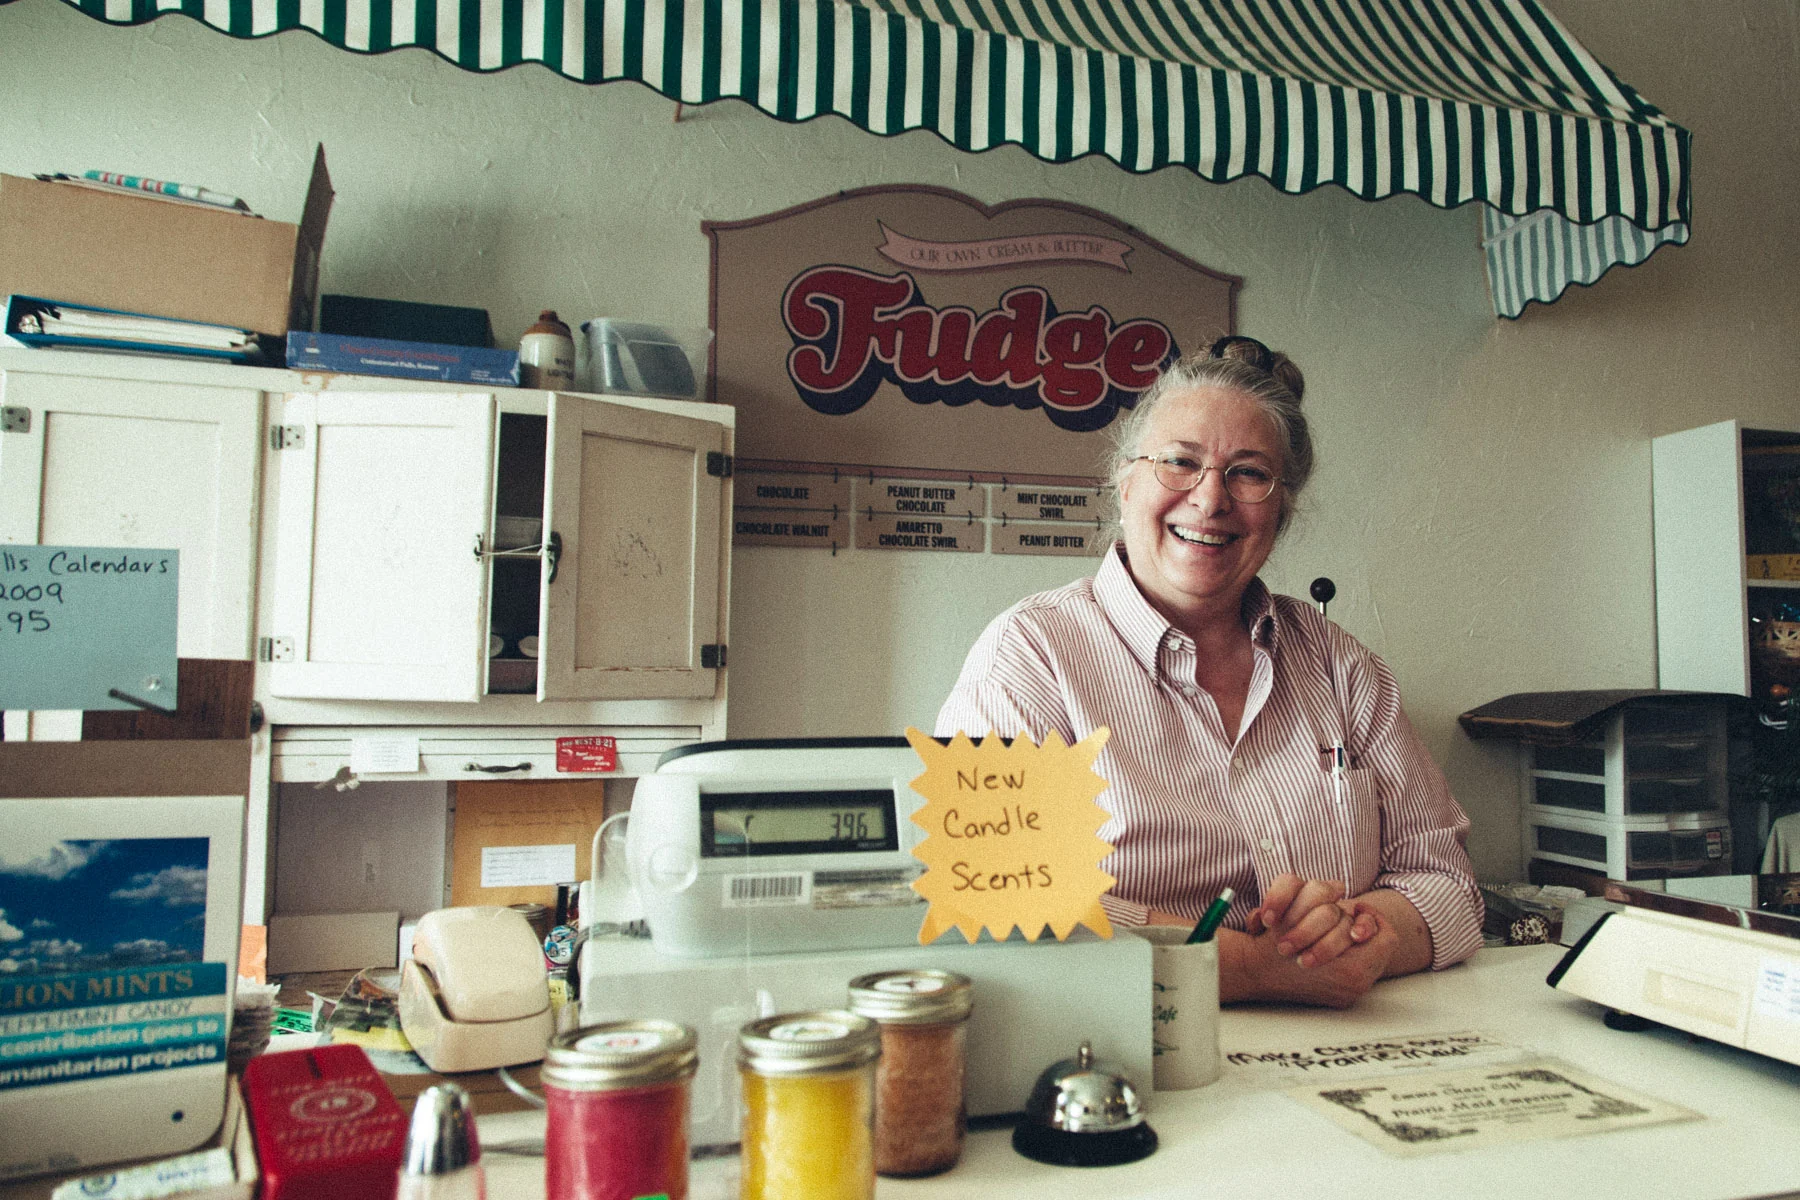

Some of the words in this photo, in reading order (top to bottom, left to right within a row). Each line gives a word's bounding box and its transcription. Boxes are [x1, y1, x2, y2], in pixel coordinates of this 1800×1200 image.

[910, 248, 940, 262] OUR
[946, 249, 981, 262] OWN
[988, 242, 1033, 258] CREAM
[780, 265, 1174, 412] Fudge
[757, 486, 809, 500] CHOCOLATE
[887, 485, 921, 498] PEANUT
[923, 487, 956, 500] BUTTER
[1017, 492, 1038, 505] MINT
[1040, 494, 1087, 507] CHOCOLATE
[896, 499, 946, 513] CHOCOLATE
[1039, 507, 1064, 519] SWIRL
[735, 521, 790, 536] CHOCOLATE
[792, 523, 829, 537] WALNUT
[895, 521, 943, 534] AMARETTO
[878, 533, 929, 548] CHOCOLATE
[931, 536, 959, 548] SWIRL
[1020, 535, 1051, 547] PEANUT
[1053, 535, 1084, 548] BUTTER
[49, 551, 169, 576] Calendars
[0, 582, 64, 604] 2009
[956, 766, 1026, 792] New
[943, 805, 1041, 839] Candle
[951, 861, 1053, 892] Scents
[86, 968, 194, 1000] MINTS
[128, 1000, 193, 1021] CANDY
[1, 1023, 139, 1058] contribution
[142, 1020, 193, 1045] goes
[197, 1019, 220, 1035] to
[131, 1043, 218, 1071] projects
